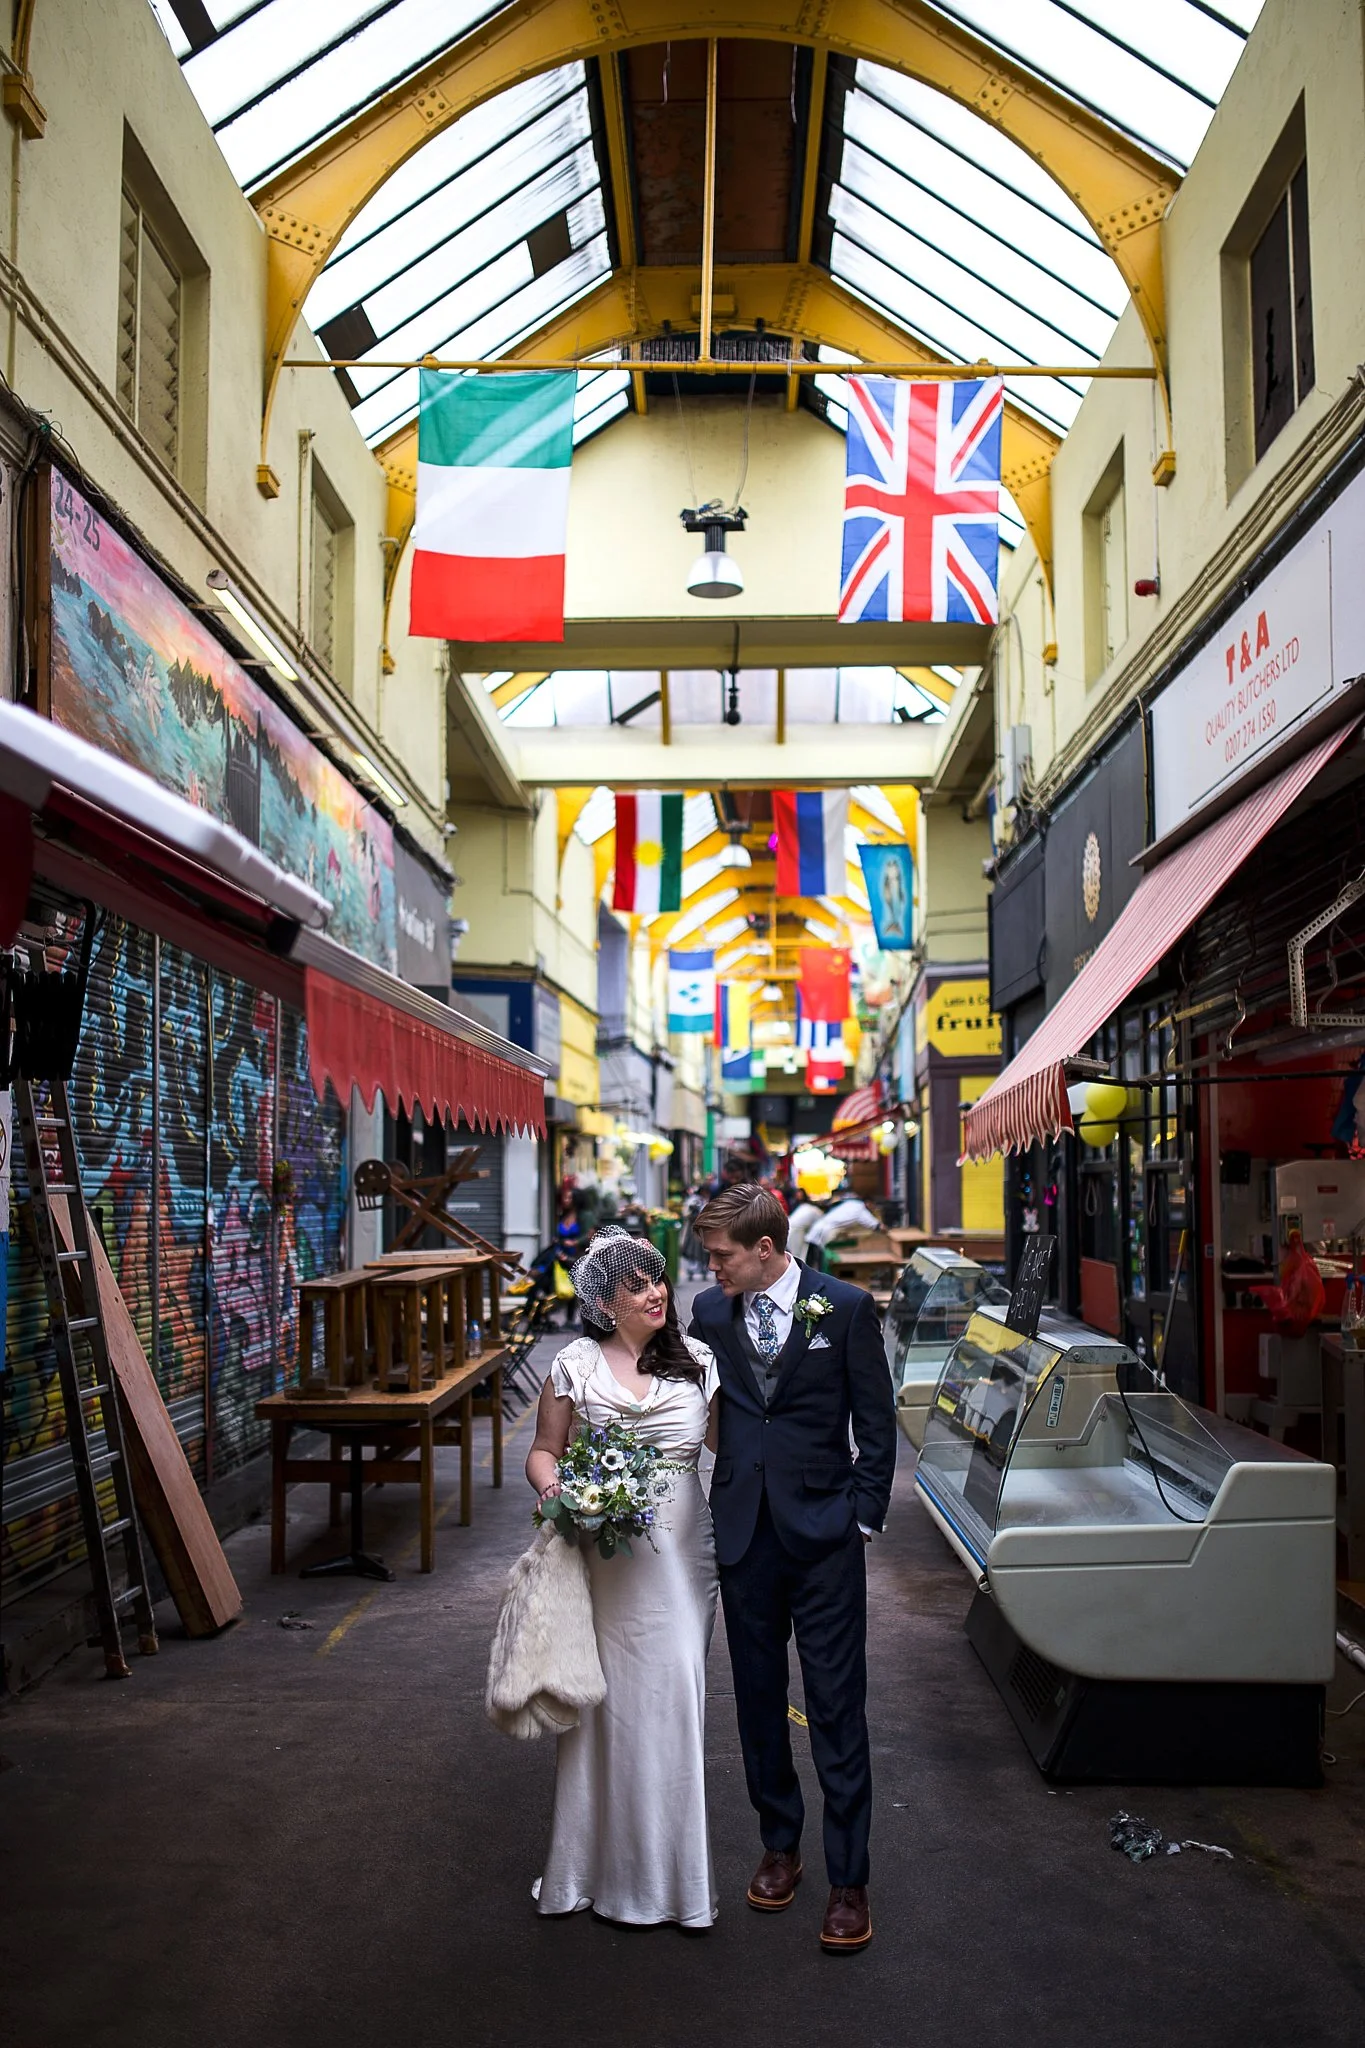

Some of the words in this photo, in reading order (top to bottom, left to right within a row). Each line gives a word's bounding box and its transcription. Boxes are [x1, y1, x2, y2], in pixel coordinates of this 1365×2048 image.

[55, 475, 100, 551] 24-25
[1206, 696, 1236, 745] QUALITY
[1238, 654, 1280, 714] BUTCHERS
[1282, 636, 1300, 672] LTD
[1225, 730, 1241, 763] 0207
[1243, 717, 1256, 748] 274
[1259, 699, 1277, 735] 1550
